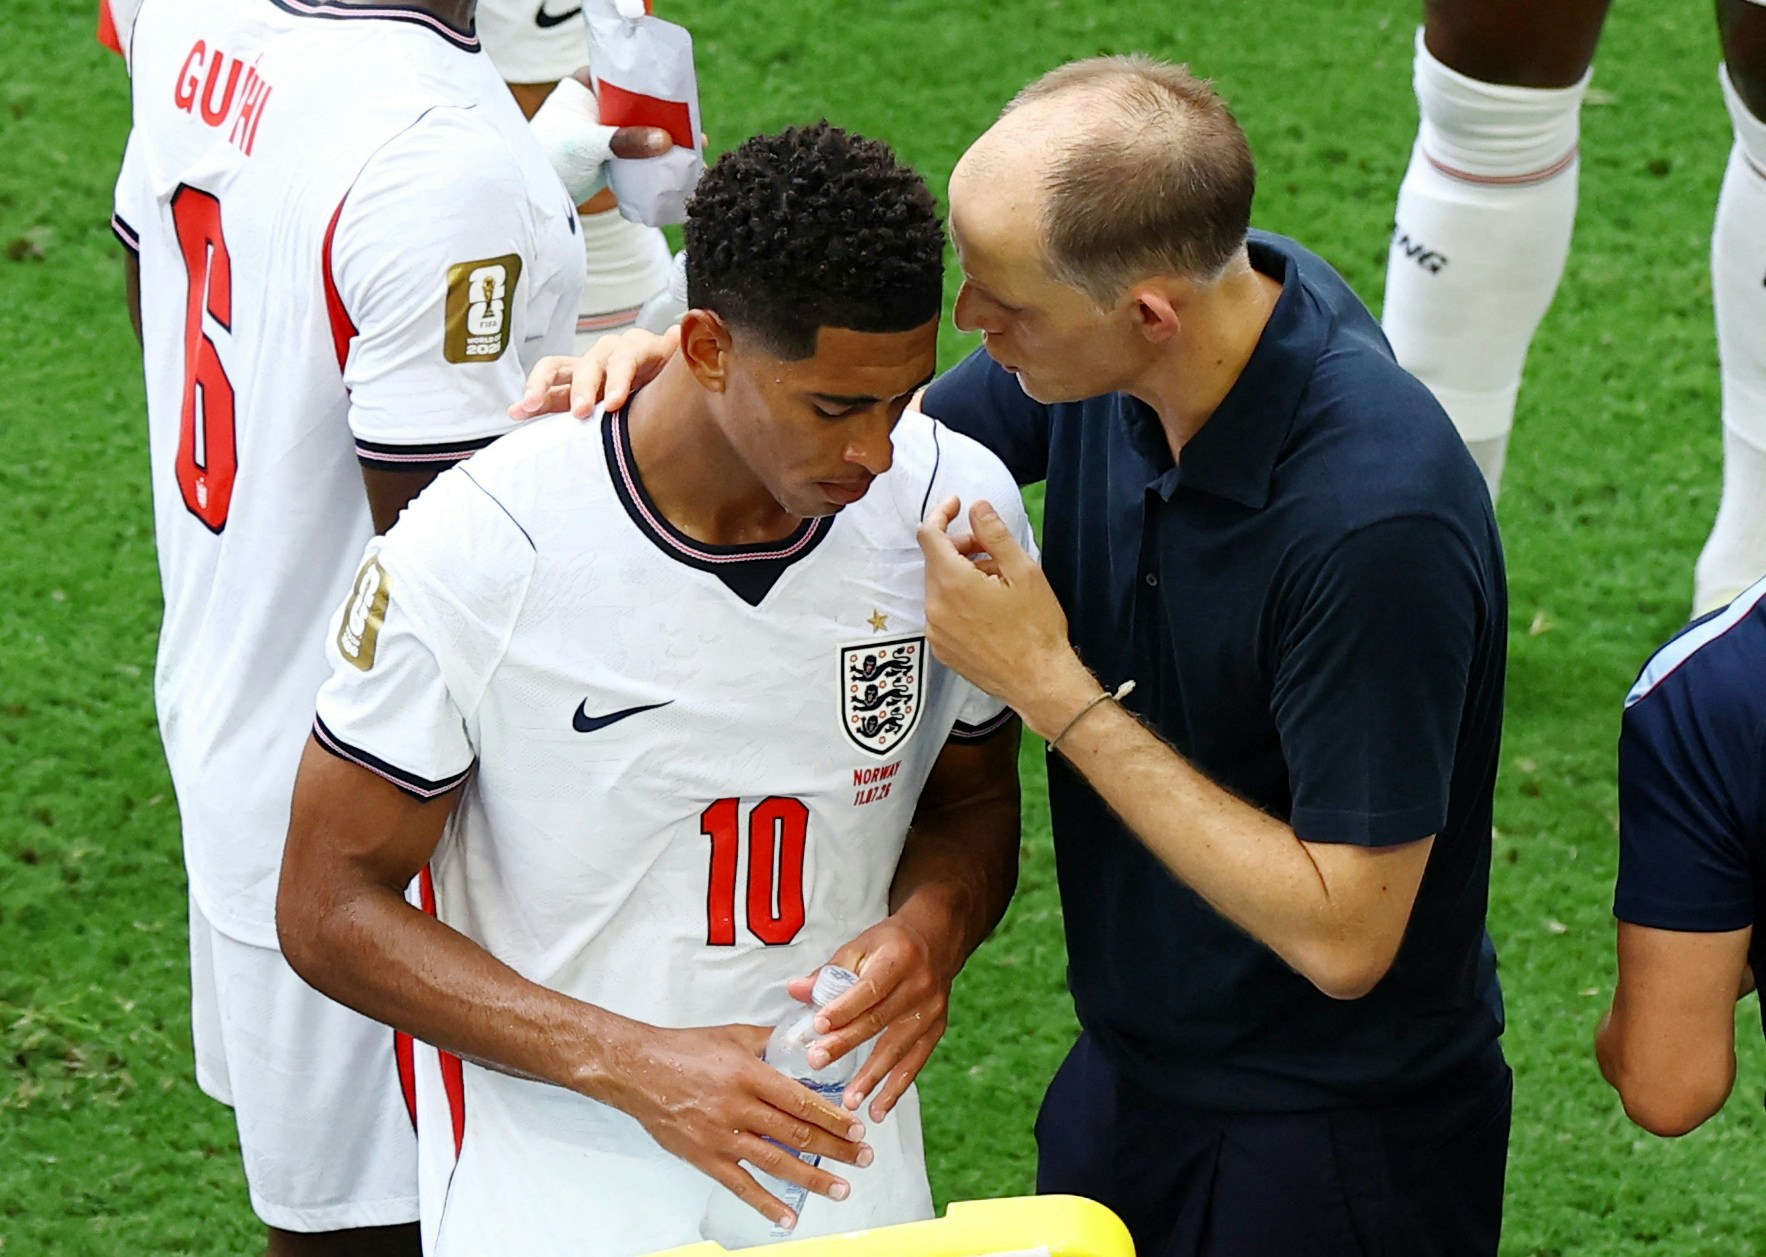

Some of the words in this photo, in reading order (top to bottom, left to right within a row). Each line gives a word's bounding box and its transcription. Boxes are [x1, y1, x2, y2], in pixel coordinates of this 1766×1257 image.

[1394, 222, 1448, 275] NG
[479, 320, 498, 329] FIFA
[170, 181, 239, 536] 6
[853, 760, 902, 786] NORWAY
[700, 795, 810, 946] 10
